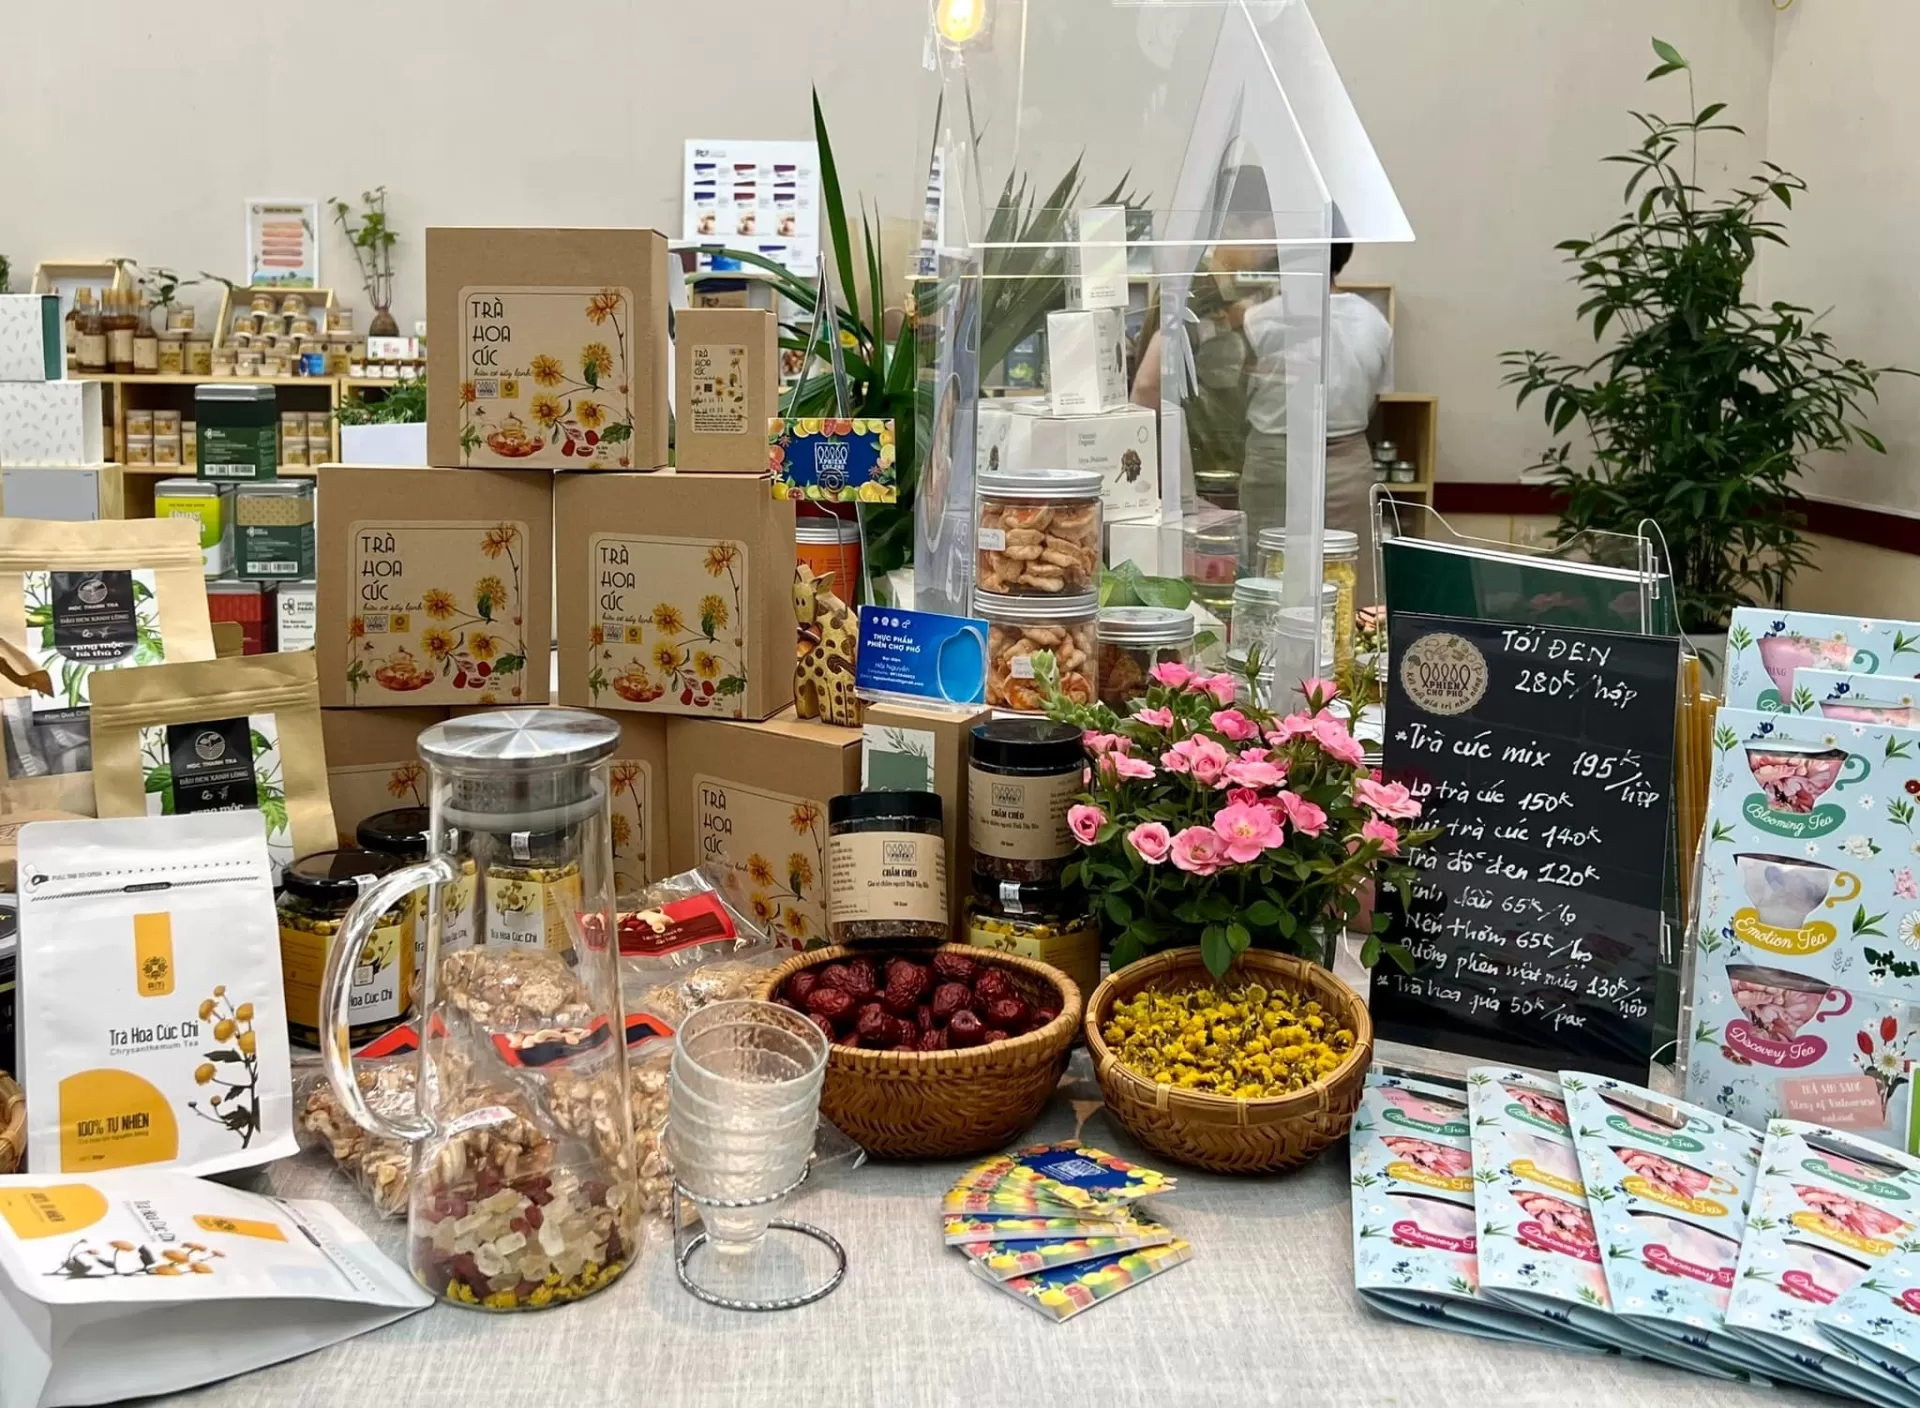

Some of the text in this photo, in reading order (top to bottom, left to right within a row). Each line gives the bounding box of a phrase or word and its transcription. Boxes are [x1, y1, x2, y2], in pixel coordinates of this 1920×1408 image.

[471, 297, 503, 318] TRÀ
[472, 325, 511, 342] HOA
[472, 345, 498, 366] CÚC
[361, 532, 395, 553] TRÀ
[600, 544, 629, 566] TRÀ
[361, 560, 402, 577] HOA
[361, 580, 388, 600] CÚC
[600, 571, 636, 589] HOA
[600, 591, 624, 612] CÚC
[888, 643, 905, 652] CHỢ
[1548, 639, 1611, 667] ĐEN
[1453, 730, 1493, 758] cúc
[1502, 740, 1551, 767] mix
[702, 789, 726, 810] TRÀ
[1410, 777, 1432, 803] Lọ
[1435, 780, 1470, 804] trà
[1476, 779, 1505, 804] cúc
[703, 812, 732, 834] HOA
[1447, 816, 1486, 841] trà
[1494, 817, 1530, 841] cúc
[1746, 803, 1834, 836] Blooming Tea
[703, 833, 723, 855] CÚC
[1407, 846, 1437, 870] Trà
[1485, 854, 1529, 881] đen
[1405, 912, 1444, 935] Nến
[1735, 917, 1828, 950] Emotion Tea
[524, 930, 537, 943] Chi
[1454, 952, 1499, 979] phèn
[381, 987, 393, 1001] Chi
[1393, 974, 1426, 996] Trà
[1427, 979, 1462, 1003] hoa
[109, 1020, 199, 1046] Trà Hoa Cúc Chi
[109, 1042, 181, 1056] Chrysanthemum
[1729, 1027, 1816, 1065] Discovery Tea
[77, 1119, 104, 1137] 100%
[121, 1112, 149, 1131] NHIÊN
[1692, 1198, 1723, 1214] Tea
